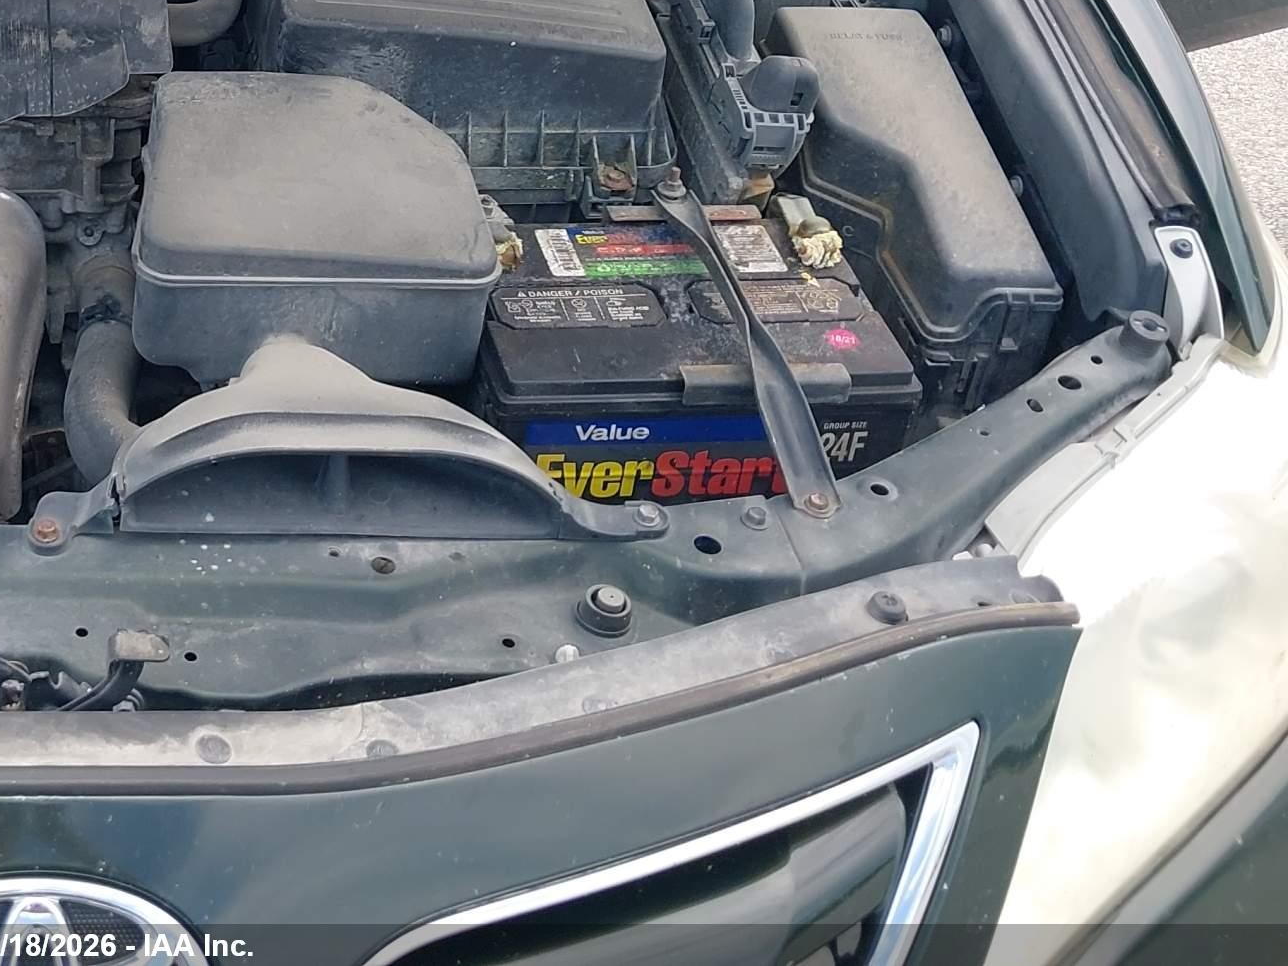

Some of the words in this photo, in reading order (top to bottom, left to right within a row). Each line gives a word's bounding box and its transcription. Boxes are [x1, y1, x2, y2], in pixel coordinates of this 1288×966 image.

[527, 290, 573, 298] DANGER
[583, 288, 624, 296] POISON
[823, 421, 851, 430] GROUP
[851, 420, 868, 429] SIZE
[575, 423, 651, 442] Value
